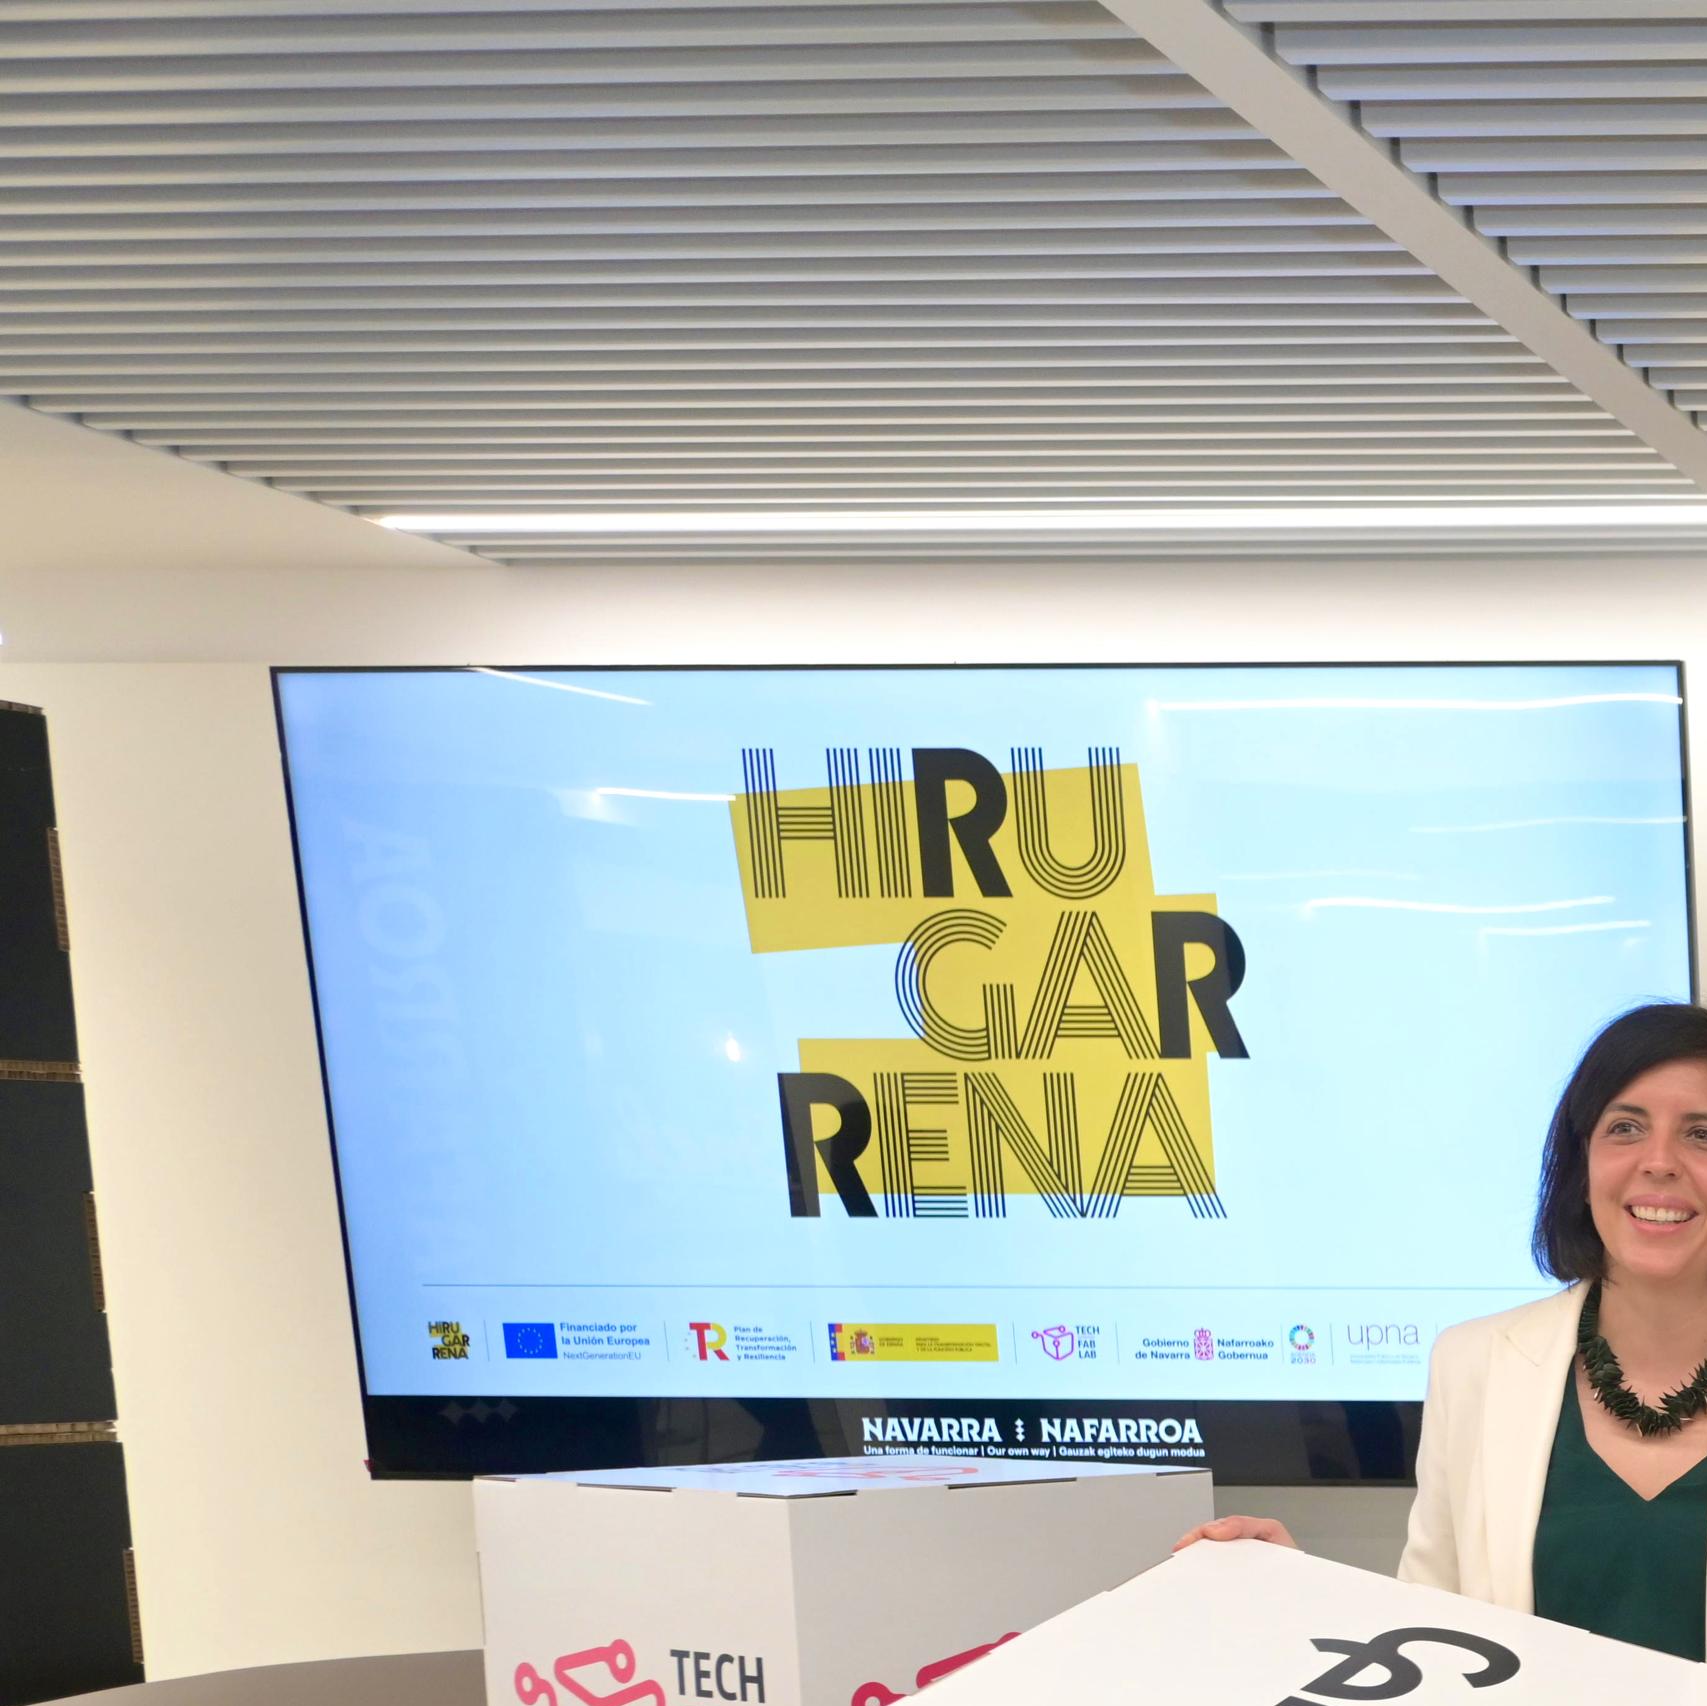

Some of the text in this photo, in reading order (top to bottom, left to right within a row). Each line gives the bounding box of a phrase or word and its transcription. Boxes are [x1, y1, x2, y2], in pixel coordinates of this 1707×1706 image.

[741, 747, 1127, 900] HIRU
[895, 910, 1250, 1060] GAR
[778, 1071, 1227, 1218] RENA
[560, 1322, 637, 1334] Financiado por
[1076, 1326, 1100, 1335] TECH
[561, 1335, 650, 1347] la Unión Europea
[1142, 1338, 1189, 1348] Gobierno
[1217, 1338, 1274, 1348] Nafarroako
[1347, 1324, 1421, 1351] upna
[1077, 1340, 1096, 1349] FAB
[562, 1350, 642, 1361] NextGenerationEU
[1078, 1351, 1097, 1359] LAB
[1135, 1350, 1190, 1360] de Navarra
[1217, 1350, 1269, 1360] Gobernua
[862, 1417, 1003, 1442] NAVARRA
[1040, 1417, 1203, 1444] NAFARROA
[863, 1445, 1205, 1460] Una forma de funcionar Our own way Gauzak egiteko dugun modua
[670, 1649, 765, 1704] TECH
